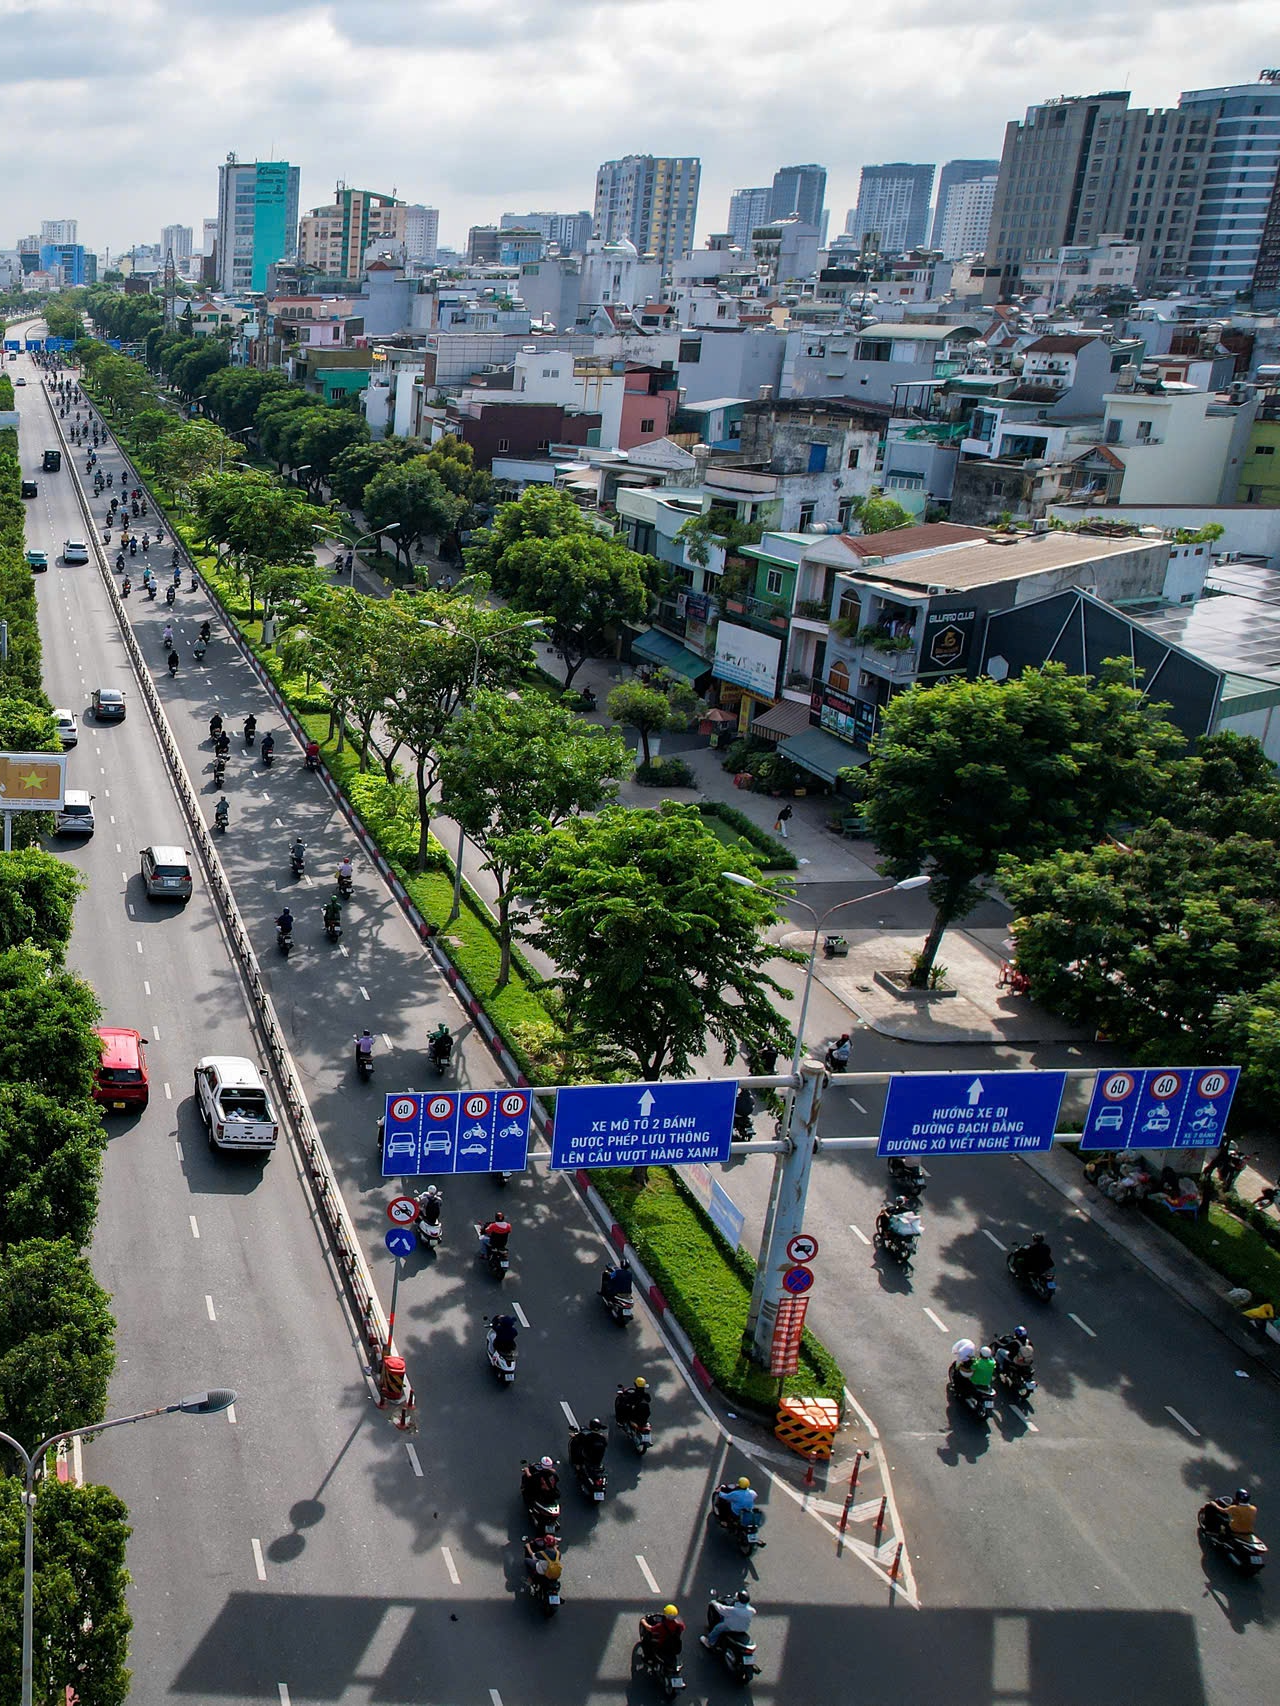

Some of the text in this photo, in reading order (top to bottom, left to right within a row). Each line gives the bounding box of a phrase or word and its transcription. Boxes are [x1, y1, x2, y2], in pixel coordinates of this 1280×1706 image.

[957, 611, 975, 621] CLUB
[1110, 1079, 1125, 1094] 60
[1157, 1078, 1173, 1093] 60
[1205, 1077, 1220, 1092] 60
[397, 1104, 409, 1115] 60
[434, 1103, 446, 1114] 60
[471, 1100, 483, 1113] 60
[506, 1098, 519, 1111] 60
[932, 1105, 1009, 1119] HƯỚNG XE ĐI
[591, 1115, 696, 1132] XE MÔ TÔ 2 BÁNH
[912, 1118, 1025, 1136] ĐƯỜNG BẠCH ĐẰNG
[570, 1130, 710, 1150] ĐƯỢC PHÉP LƯU THÔNG
[886, 1132, 1041, 1151] ĐƯỜNG XÔ VIẾT NGHỆ TĨNH
[561, 1145, 719, 1165] LÊN CẦU VƯỢT HÀNG XANH
